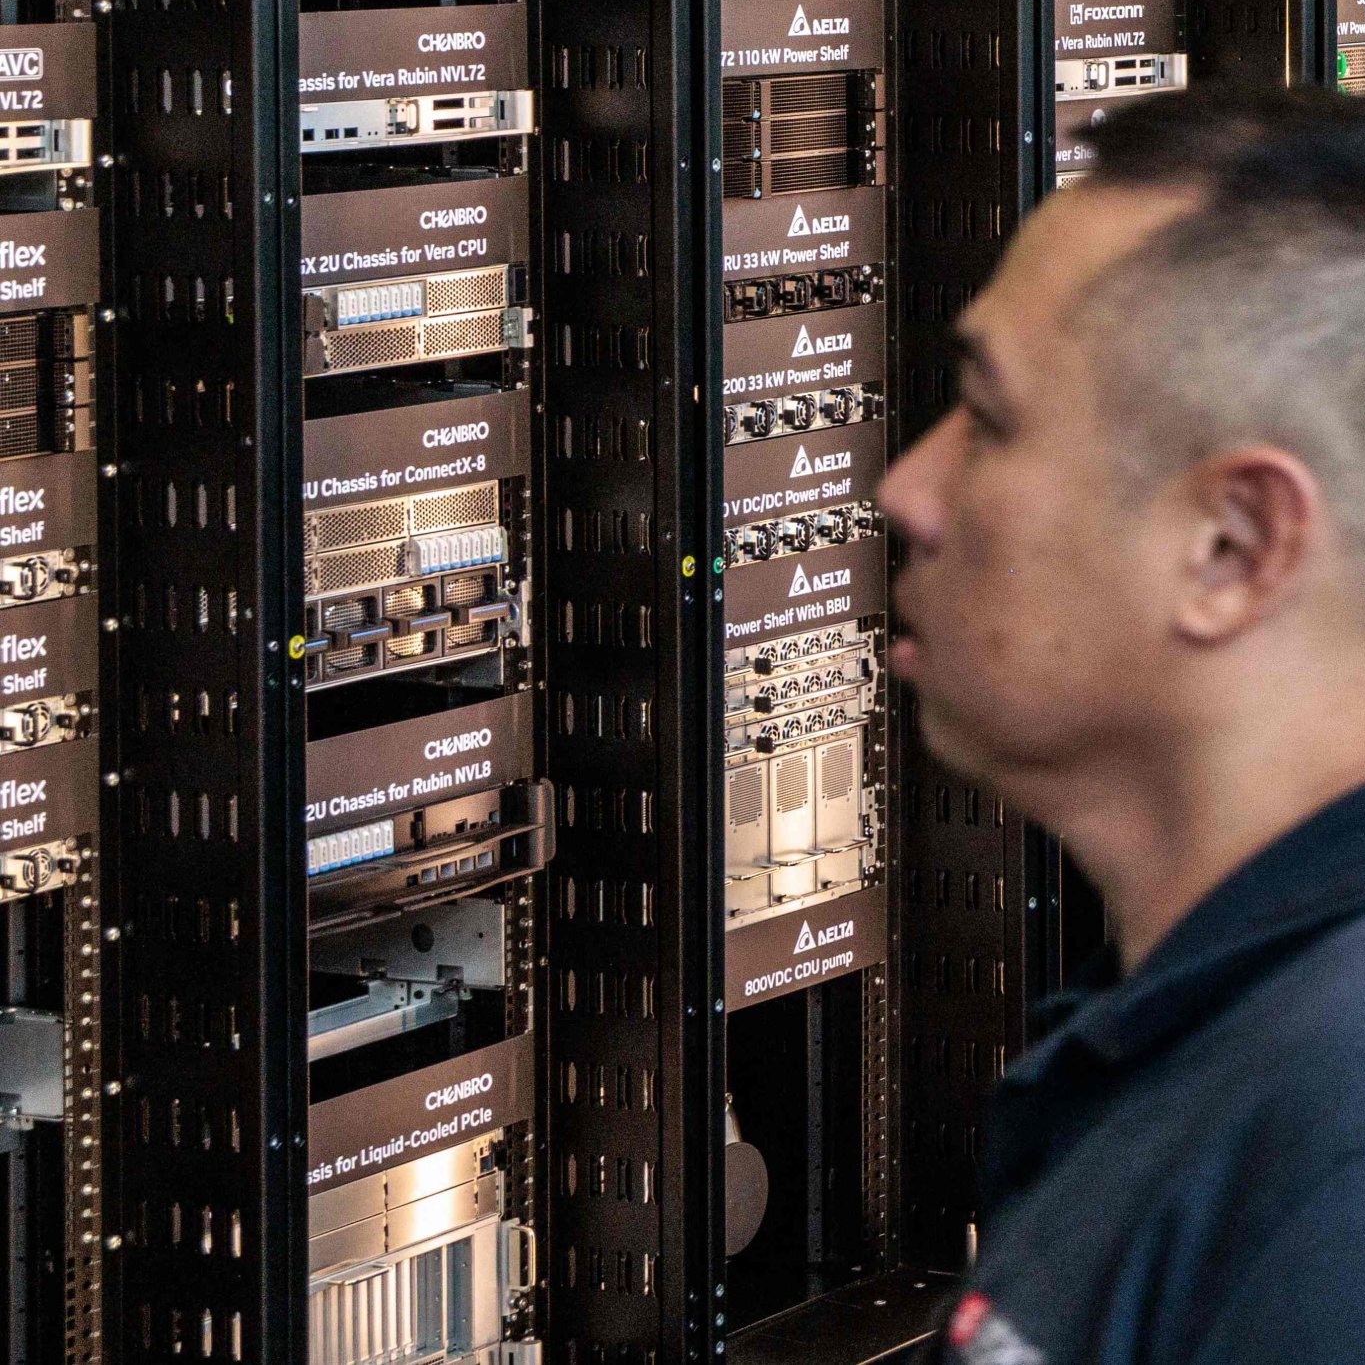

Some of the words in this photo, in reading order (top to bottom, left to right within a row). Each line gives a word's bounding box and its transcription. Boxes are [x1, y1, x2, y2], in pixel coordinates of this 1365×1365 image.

[812, 17, 850, 35] DELTA
[417, 31, 486, 53] CHENBRO
[738, 49, 760, 65] 110
[761, 48, 781, 65] kW
[783, 47, 818, 63] Power
[820, 44, 849, 61] Shelf
[1061, 35, 1084, 51] Vera
[1085, 33, 1112, 50] Rubin
[1113, 31, 1145, 48] NVL72
[0, 52, 40, 76] AVC
[299, 72, 335, 92] assis
[337, 71, 360, 89] for
[362, 70, 395, 88] Vera
[398, 67, 438, 85] Rubin
[440, 63, 485, 83] NVL72
[0, 90, 44, 110] VL72
[420, 205, 488, 230] CHENBRO
[812, 214, 850, 235] DELTA
[0, 240, 46, 269] flex
[319, 254, 340, 273] 2U
[343, 248, 398, 271] Chassis
[400, 245, 423, 264] for
[424, 242, 456, 262] Vera
[457, 238, 487, 258] CPU
[743, 252, 759, 269] 33
[760, 249, 781, 267] kW
[783, 248, 818, 265] Power
[819, 241, 850, 261] Shelf
[0, 276, 46, 301] Shelf
[816, 333, 852, 354] DELTA
[723, 378, 746, 395] 200
[748, 374, 763, 391] 33
[765, 370, 785, 389] kW
[787, 368, 821, 385] Power
[823, 359, 852, 379] Shelf
[423, 421, 490, 448] CHENBRO
[321, 472, 379, 496] Chassis
[380, 469, 402, 487] for
[404, 454, 486, 483] ConnectX-8
[814, 451, 851, 473] DELTA
[0, 485, 45, 516] flex
[743, 493, 783, 513] DC/DC
[785, 487, 820, 506] Power
[822, 477, 851, 499] Shelf
[0, 520, 45, 547] Shelf
[812, 568, 851, 591] DELTA
[725, 618, 762, 639] Power
[763, 607, 795, 630] Shelf
[796, 601, 824, 622] With
[826, 595, 850, 615] BBU
[1, 635, 47, 663] flex
[3, 667, 47, 695] Shelf
[424, 727, 492, 760] CHENBRO
[0, 779, 47, 809] flex
[305, 800, 327, 822] 2U
[329, 787, 386, 816] Chassis
[388, 783, 410, 802] for
[412, 771, 453, 797] Rubin
[455, 760, 492, 785] NVL8
[2, 811, 47, 840] Shelf
[817, 920, 854, 946] DELTA
[744, 967, 793, 997] 800VDC
[794, 958, 820, 980] CDU
[821, 950, 854, 975] pump
[425, 1072, 493, 1111] CHENBRO
[335, 1153, 358, 1175] for
[361, 1117, 458, 1167] Liquid-Cooled
[460, 1107, 493, 1131] PCIe
